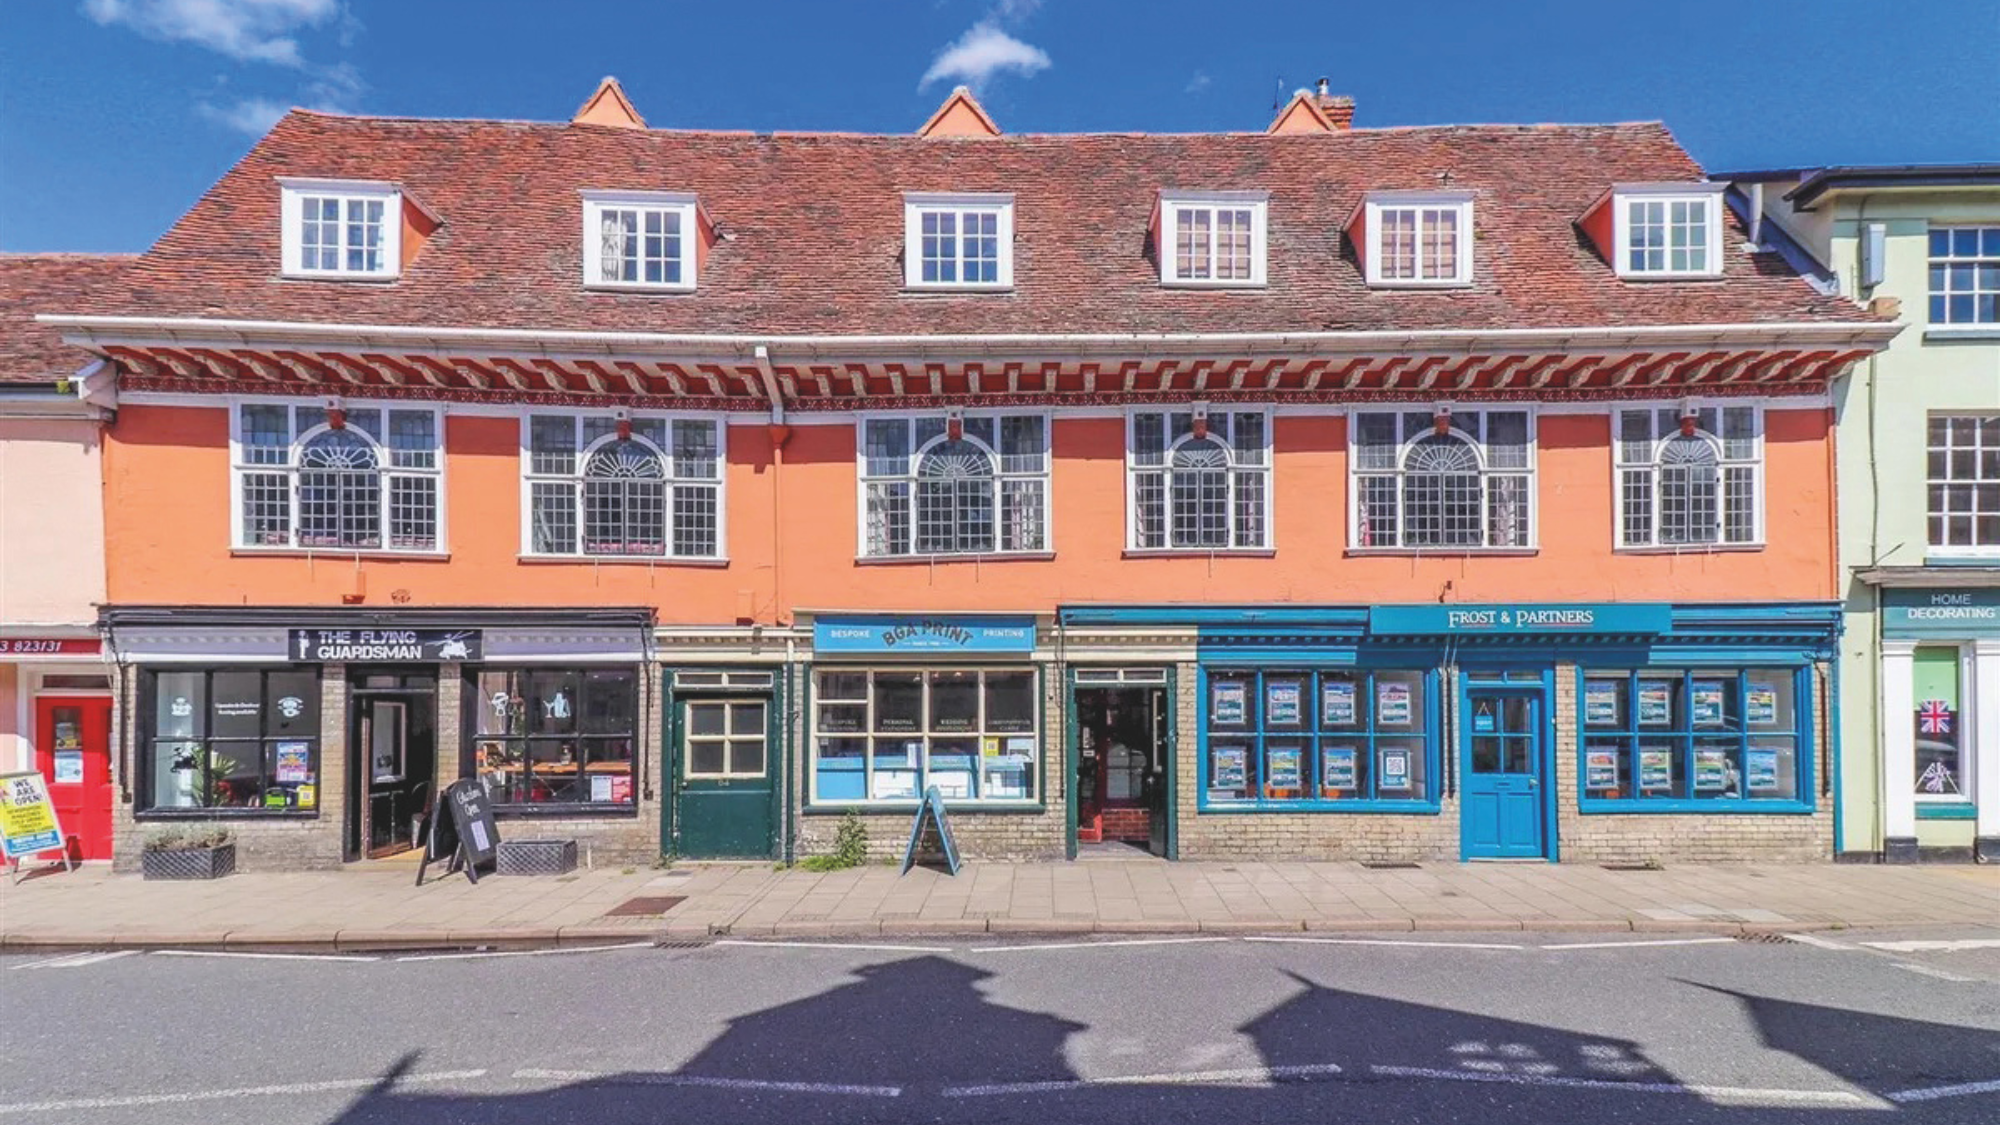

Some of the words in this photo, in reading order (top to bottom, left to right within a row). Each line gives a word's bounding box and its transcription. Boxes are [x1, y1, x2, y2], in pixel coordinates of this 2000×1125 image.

[1931, 593, 1972, 605] HOME
[1448, 610, 1497, 628] FROST
[1500, 611, 1511, 624] &
[1516, 610, 1594, 628] PARTNERS
[1907, 607, 1996, 619] DECORATING
[318, 630, 352, 645] THE
[359, 630, 417, 645] FLYING
[831, 629, 871, 638] BESPOKE
[881, 623, 918, 647] BGA
[921, 619, 974, 646] PRINT
[983, 629, 1024, 638] PRINTING
[317, 645, 422, 660] GUARDSMAN
[13, 779, 30, 788] WE
[16, 786, 35, 797] ARE
